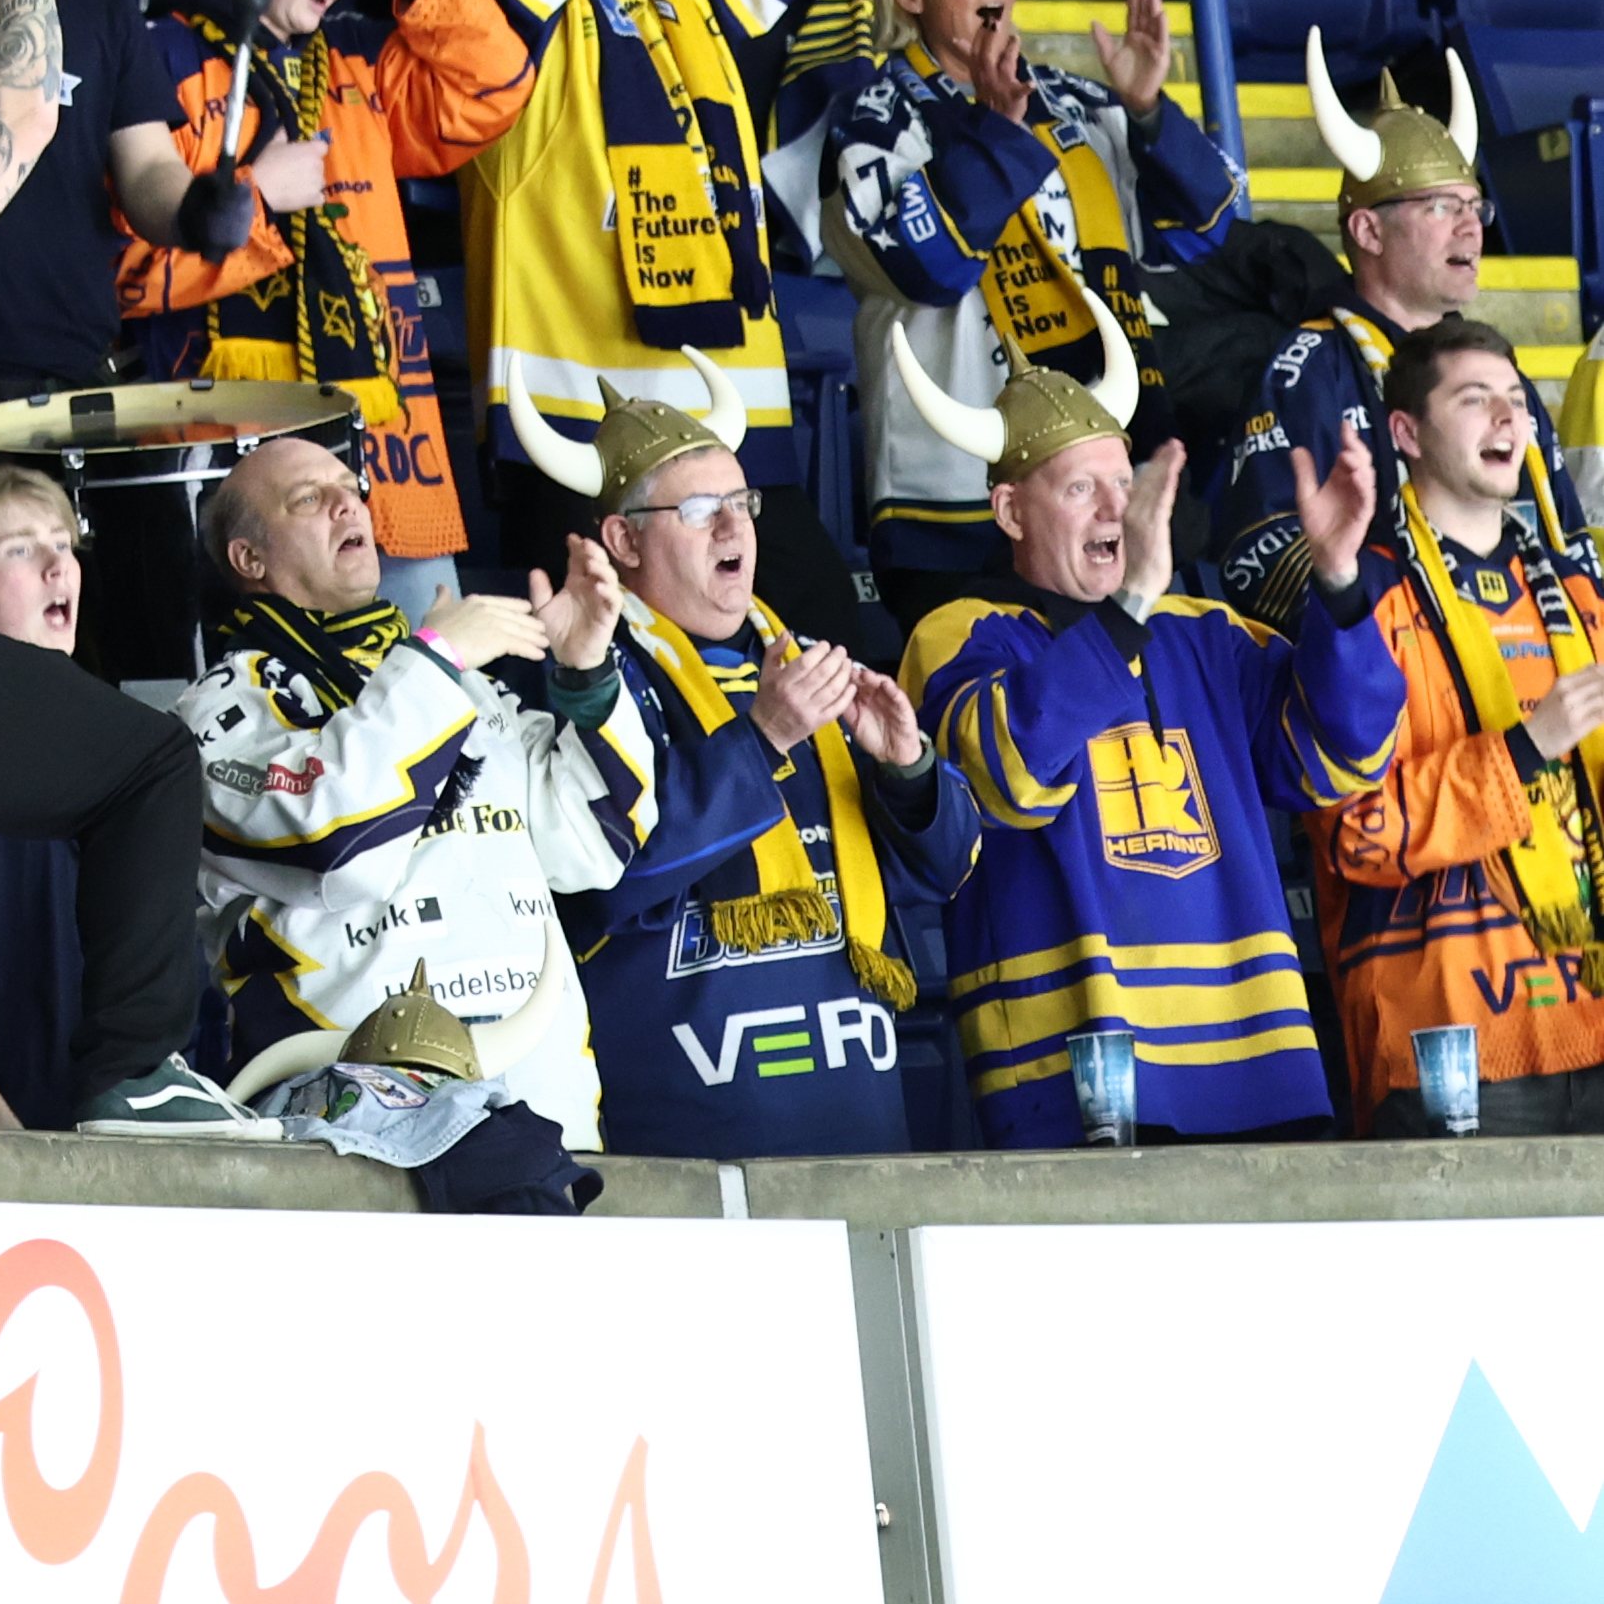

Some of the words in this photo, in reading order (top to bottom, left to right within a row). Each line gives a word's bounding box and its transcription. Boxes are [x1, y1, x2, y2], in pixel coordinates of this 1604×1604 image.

[630, 190, 677, 213] The
[632, 215, 717, 239] Future
[635, 243, 656, 265] Is
[992, 243, 1038, 269] The
[638, 266, 696, 289] Now
[1003, 294, 1031, 318] Is
[1012, 310, 1068, 340] Now
[860, 574, 876, 600] 5
[344, 903, 410, 949] kvik
